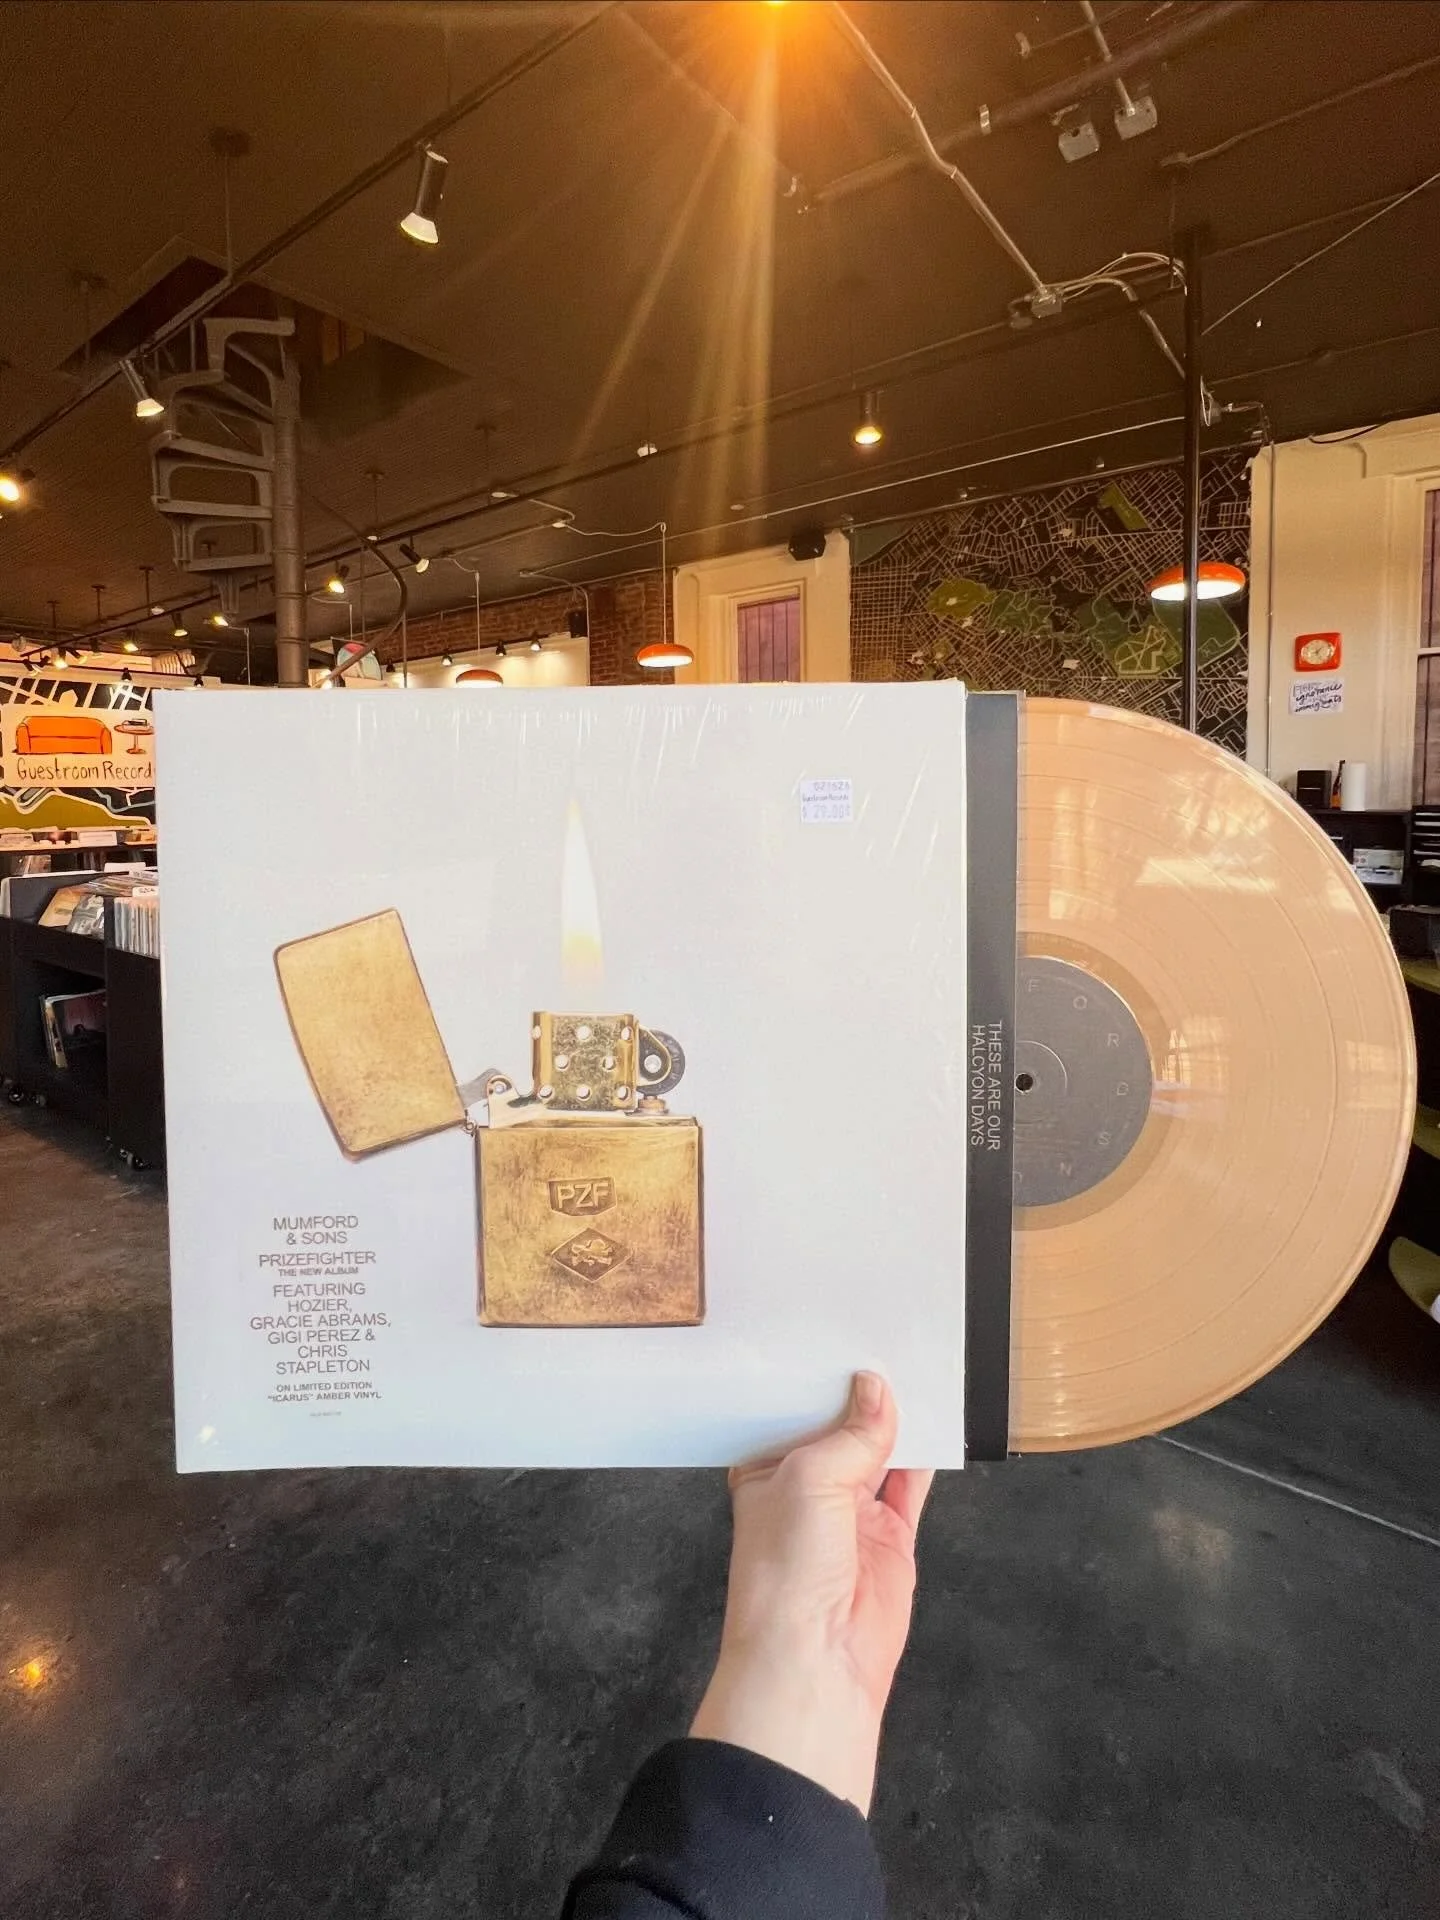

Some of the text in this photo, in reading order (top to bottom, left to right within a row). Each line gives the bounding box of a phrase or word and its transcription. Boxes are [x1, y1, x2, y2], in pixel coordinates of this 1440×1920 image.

[17, 757, 154, 779] Guestroom Record
[971, 1024, 986, 1146] HALCYON DAYS
[987, 1020, 1002, 1152] THESE ARE OUR
[557, 1182, 609, 1209] PZF
[273, 1216, 358, 1232] MUMFORD
[286, 1231, 347, 1245] & SONS
[259, 1251, 376, 1268] PRIZEFIGHTER
[325, 1267, 358, 1275] ALBUM
[273, 1282, 366, 1297] FEATURING
[288, 1299, 352, 1313] HOZIER,
[250, 1312, 391, 1331] GRACIE ABRAMS,
[268, 1329, 375, 1344] GIGI PEREZ &
[298, 1344, 347, 1358] CHRIS
[276, 1360, 370, 1375] STAPLETON
[276, 1384, 290, 1392] ON
[294, 1383, 331, 1391] LIMITED
[316, 1392, 350, 1400] AMBER
[354, 1392, 382, 1400] VINYL
